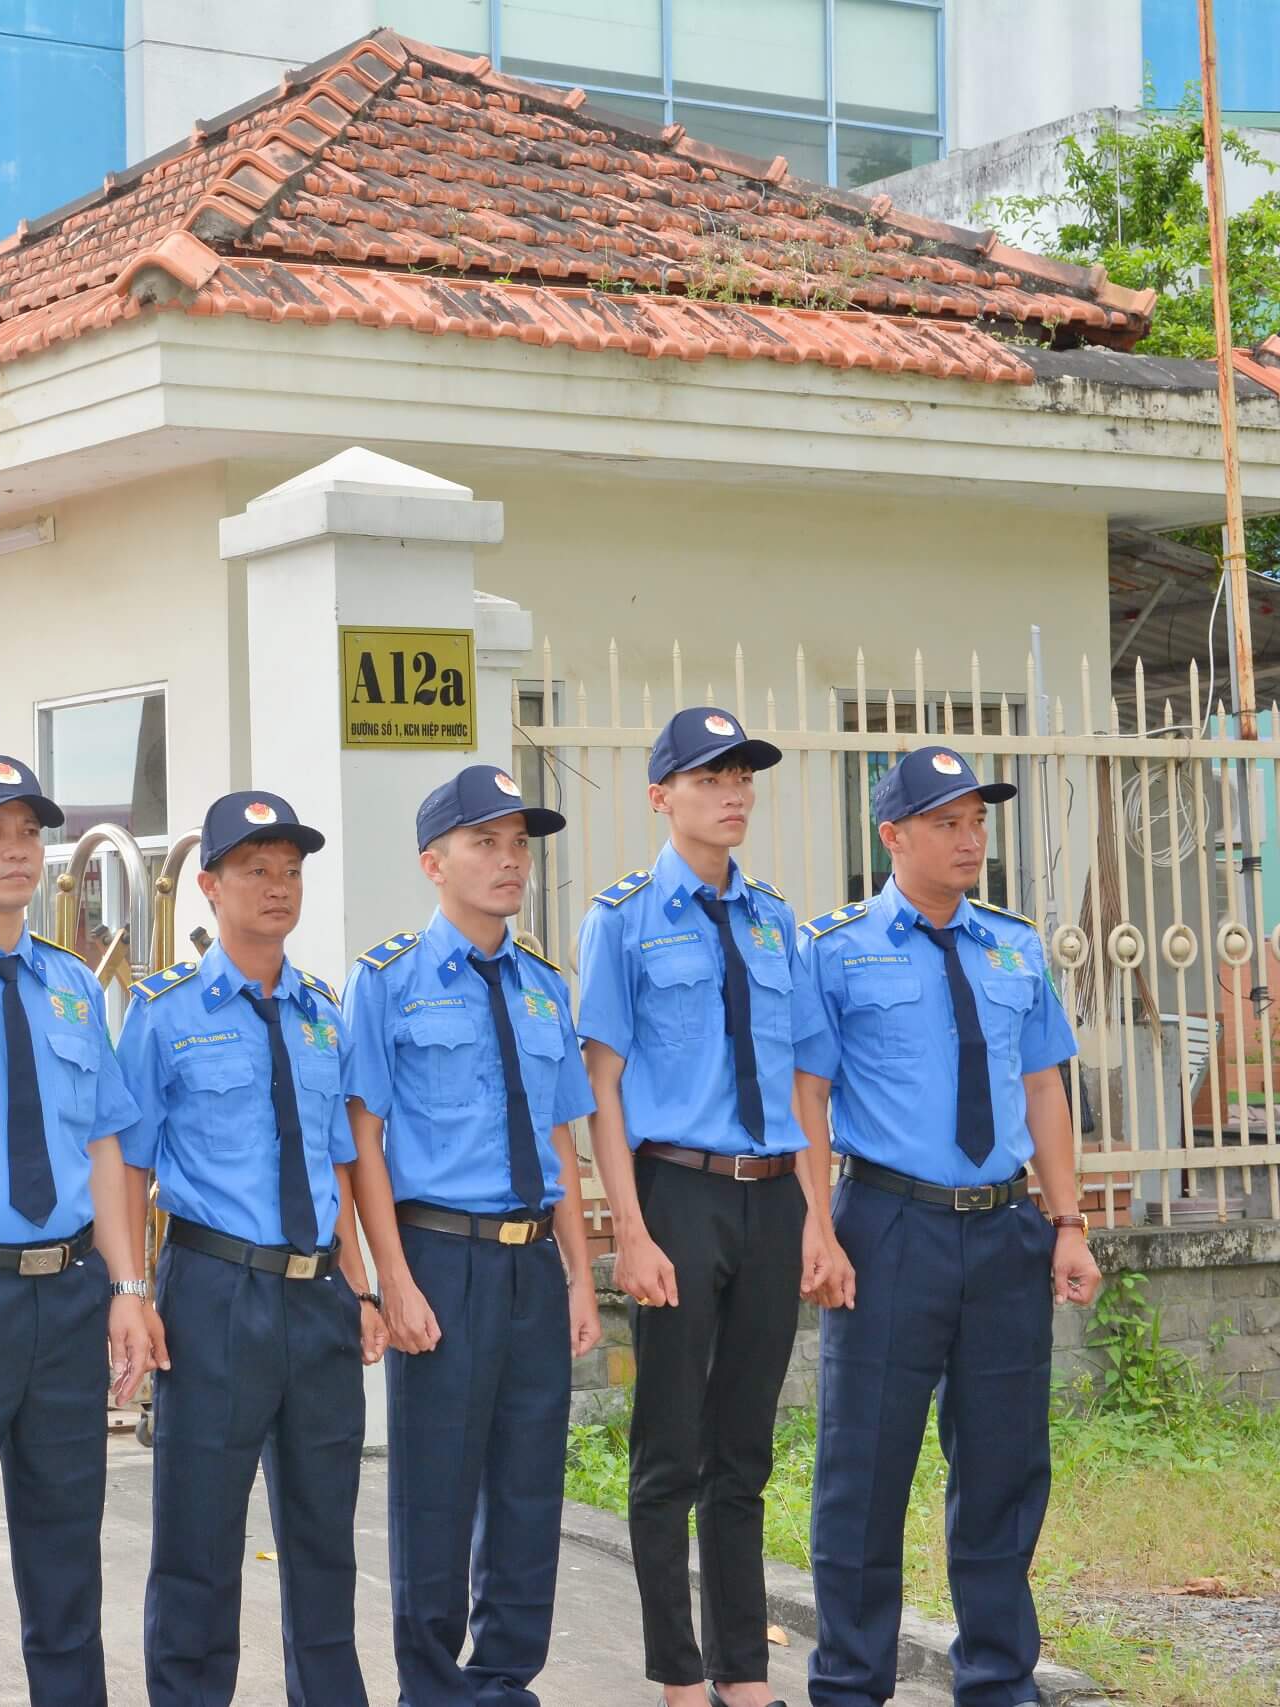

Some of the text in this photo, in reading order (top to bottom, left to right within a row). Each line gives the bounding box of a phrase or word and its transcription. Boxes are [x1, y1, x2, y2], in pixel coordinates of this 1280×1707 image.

[351, 651, 466, 707] A12a
[351, 719, 379, 736] ĐƯỜNG
[381, 718, 393, 736] SỐ
[403, 723, 420, 737] KCN
[421, 720, 439, 739] HIỆP
[441, 720, 468, 737] PHƯỚC
